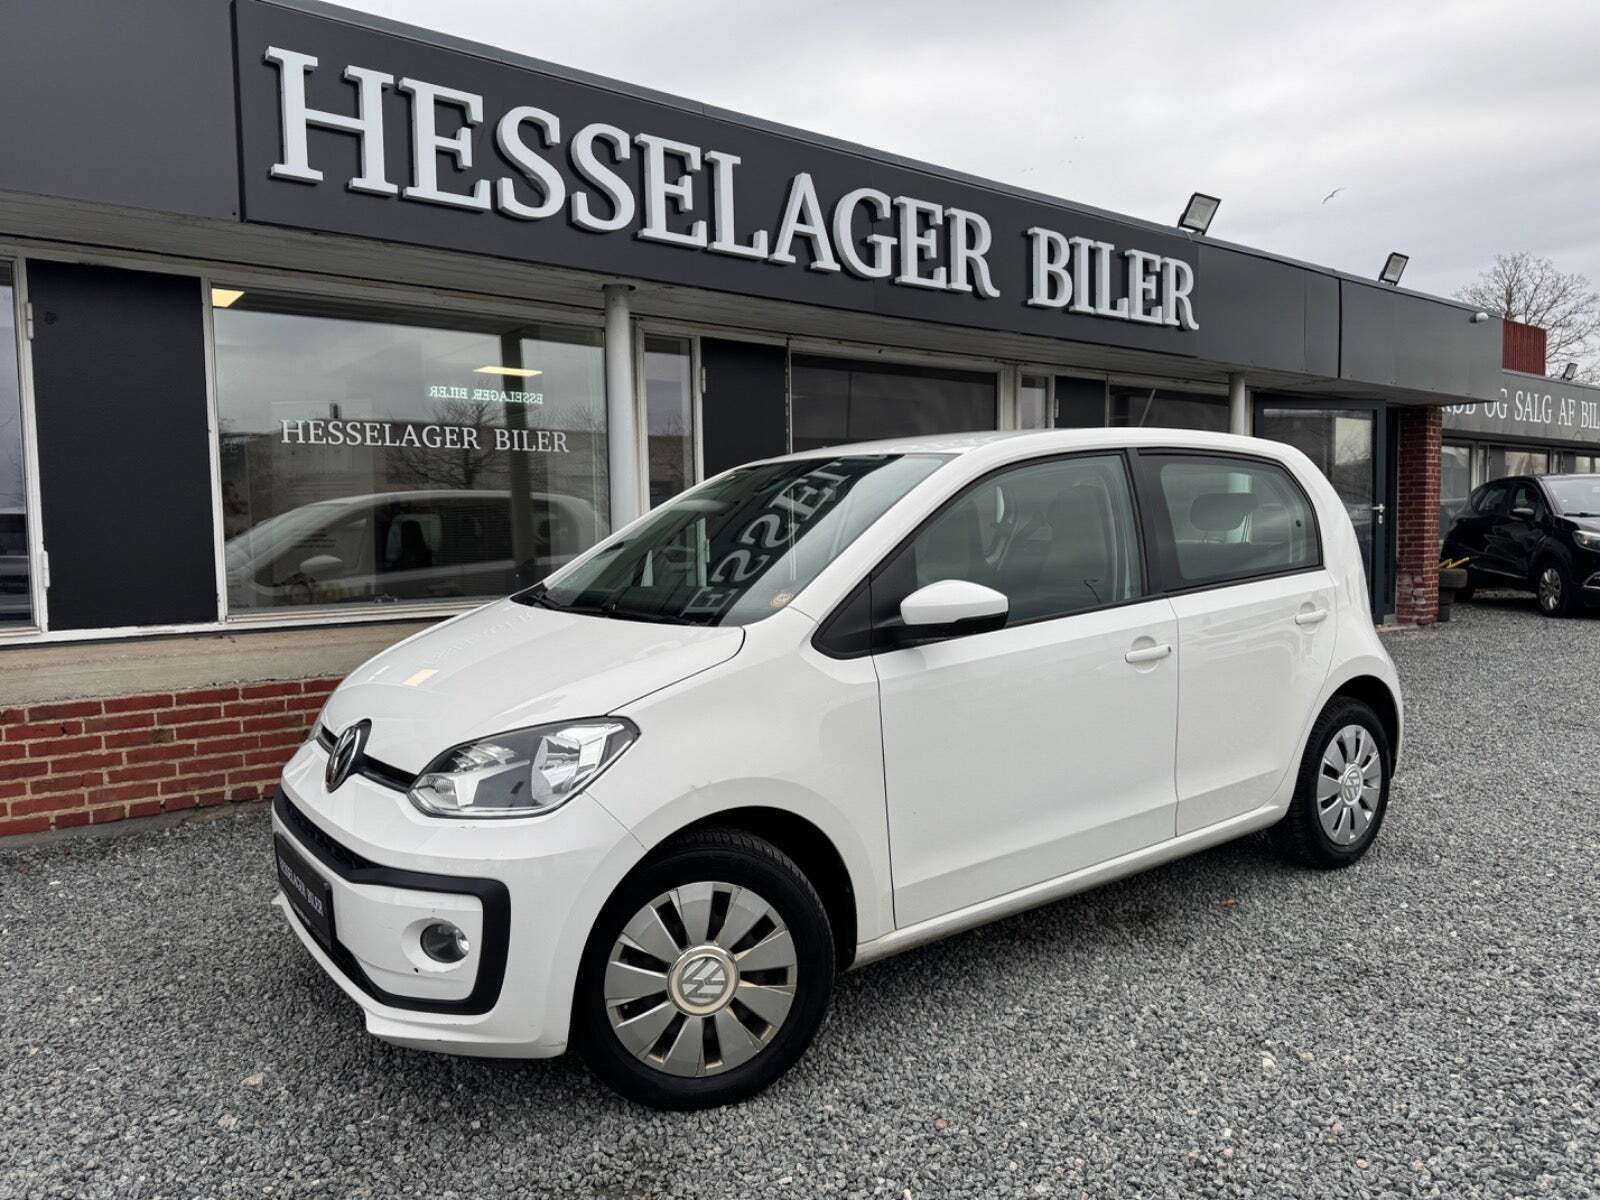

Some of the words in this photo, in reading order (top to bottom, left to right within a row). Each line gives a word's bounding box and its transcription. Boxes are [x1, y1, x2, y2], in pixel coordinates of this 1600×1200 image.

[265, 46, 1000, 298] HESSELAGER
[1027, 226, 1199, 330] BILER
[1514, 390, 1552, 424] SALG
[1558, 397, 1576, 427] AF
[280, 419, 481, 450] HESSELAGER
[495, 428, 570, 453] BILER
